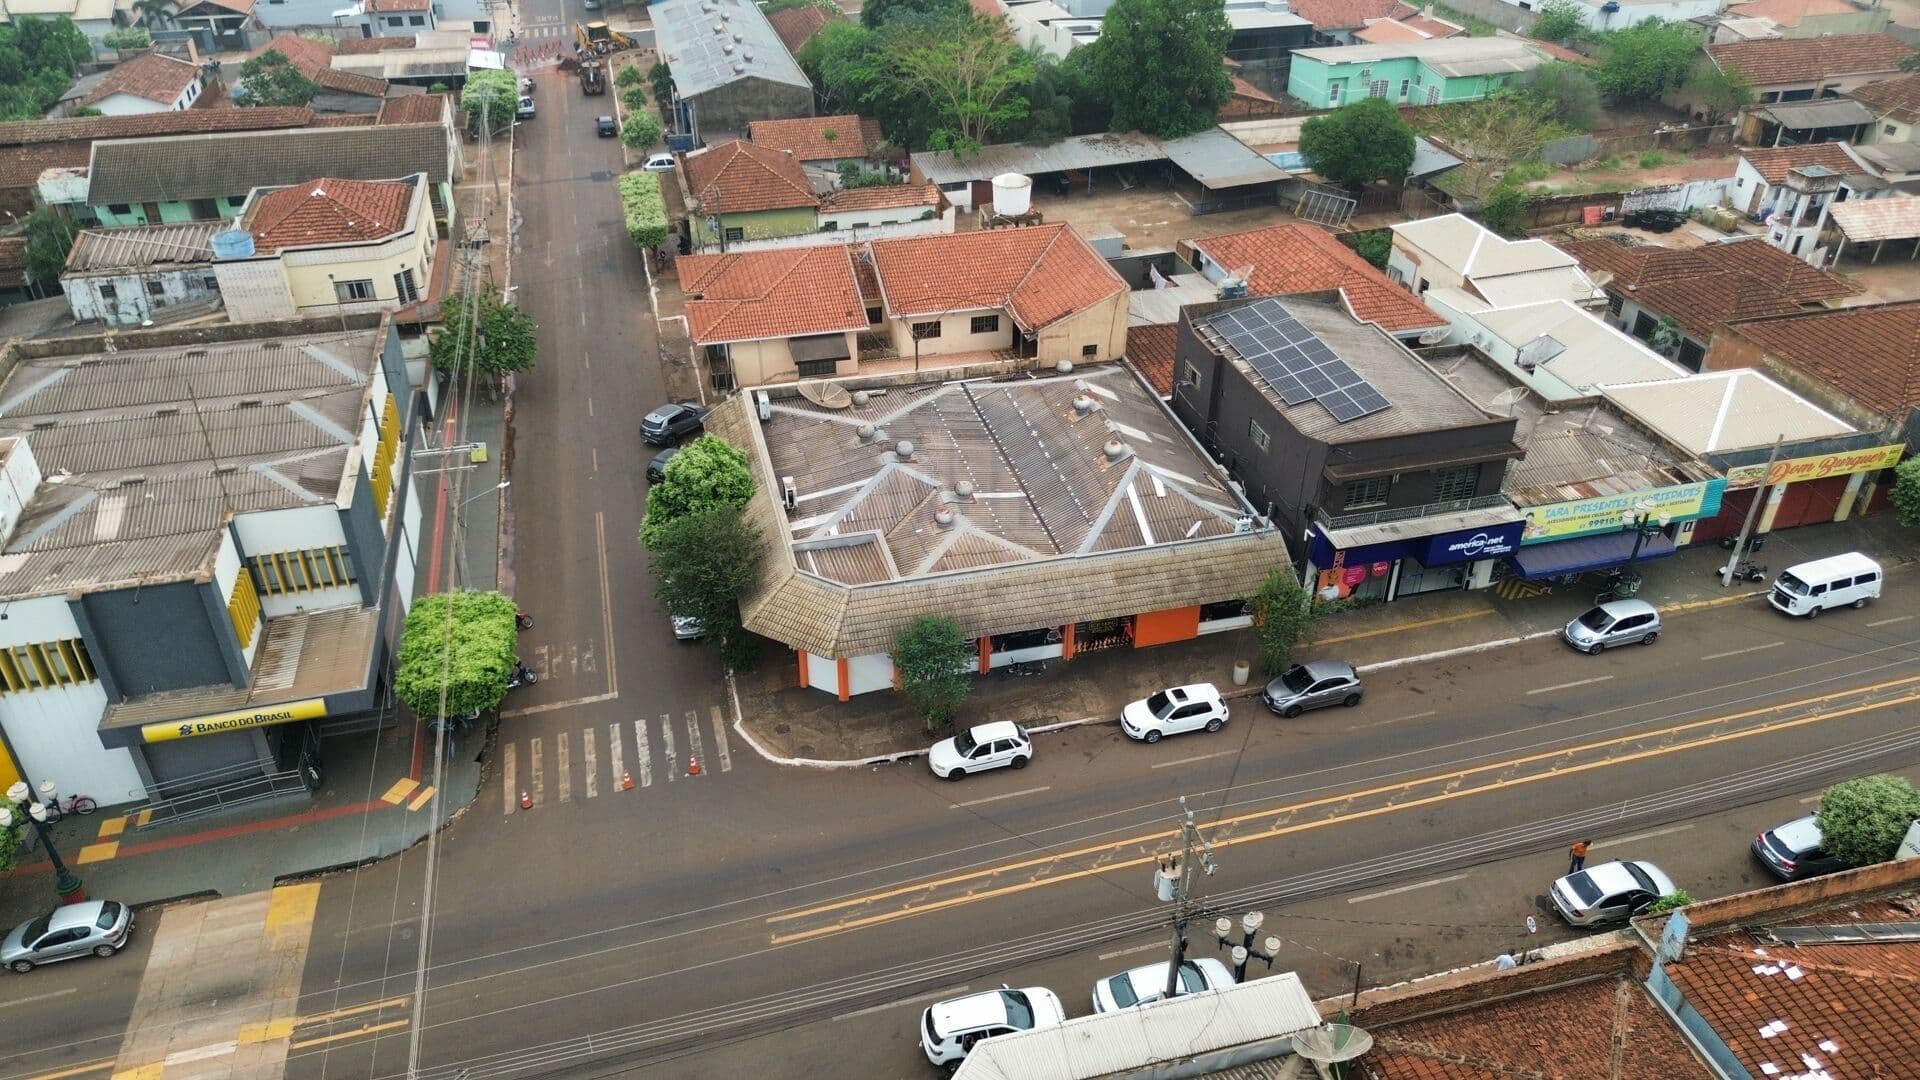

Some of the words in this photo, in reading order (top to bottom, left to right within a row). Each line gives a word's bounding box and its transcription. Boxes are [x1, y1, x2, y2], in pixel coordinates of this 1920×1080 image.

[1767, 462, 1815, 484] Dom
[1817, 450, 1886, 477] Burguer
[1573, 500, 1628, 514] PRESENTES
[199, 719, 237, 732] BANCO
[238, 717, 254, 726] DO
[255, 712, 292, 723] BRASIL
